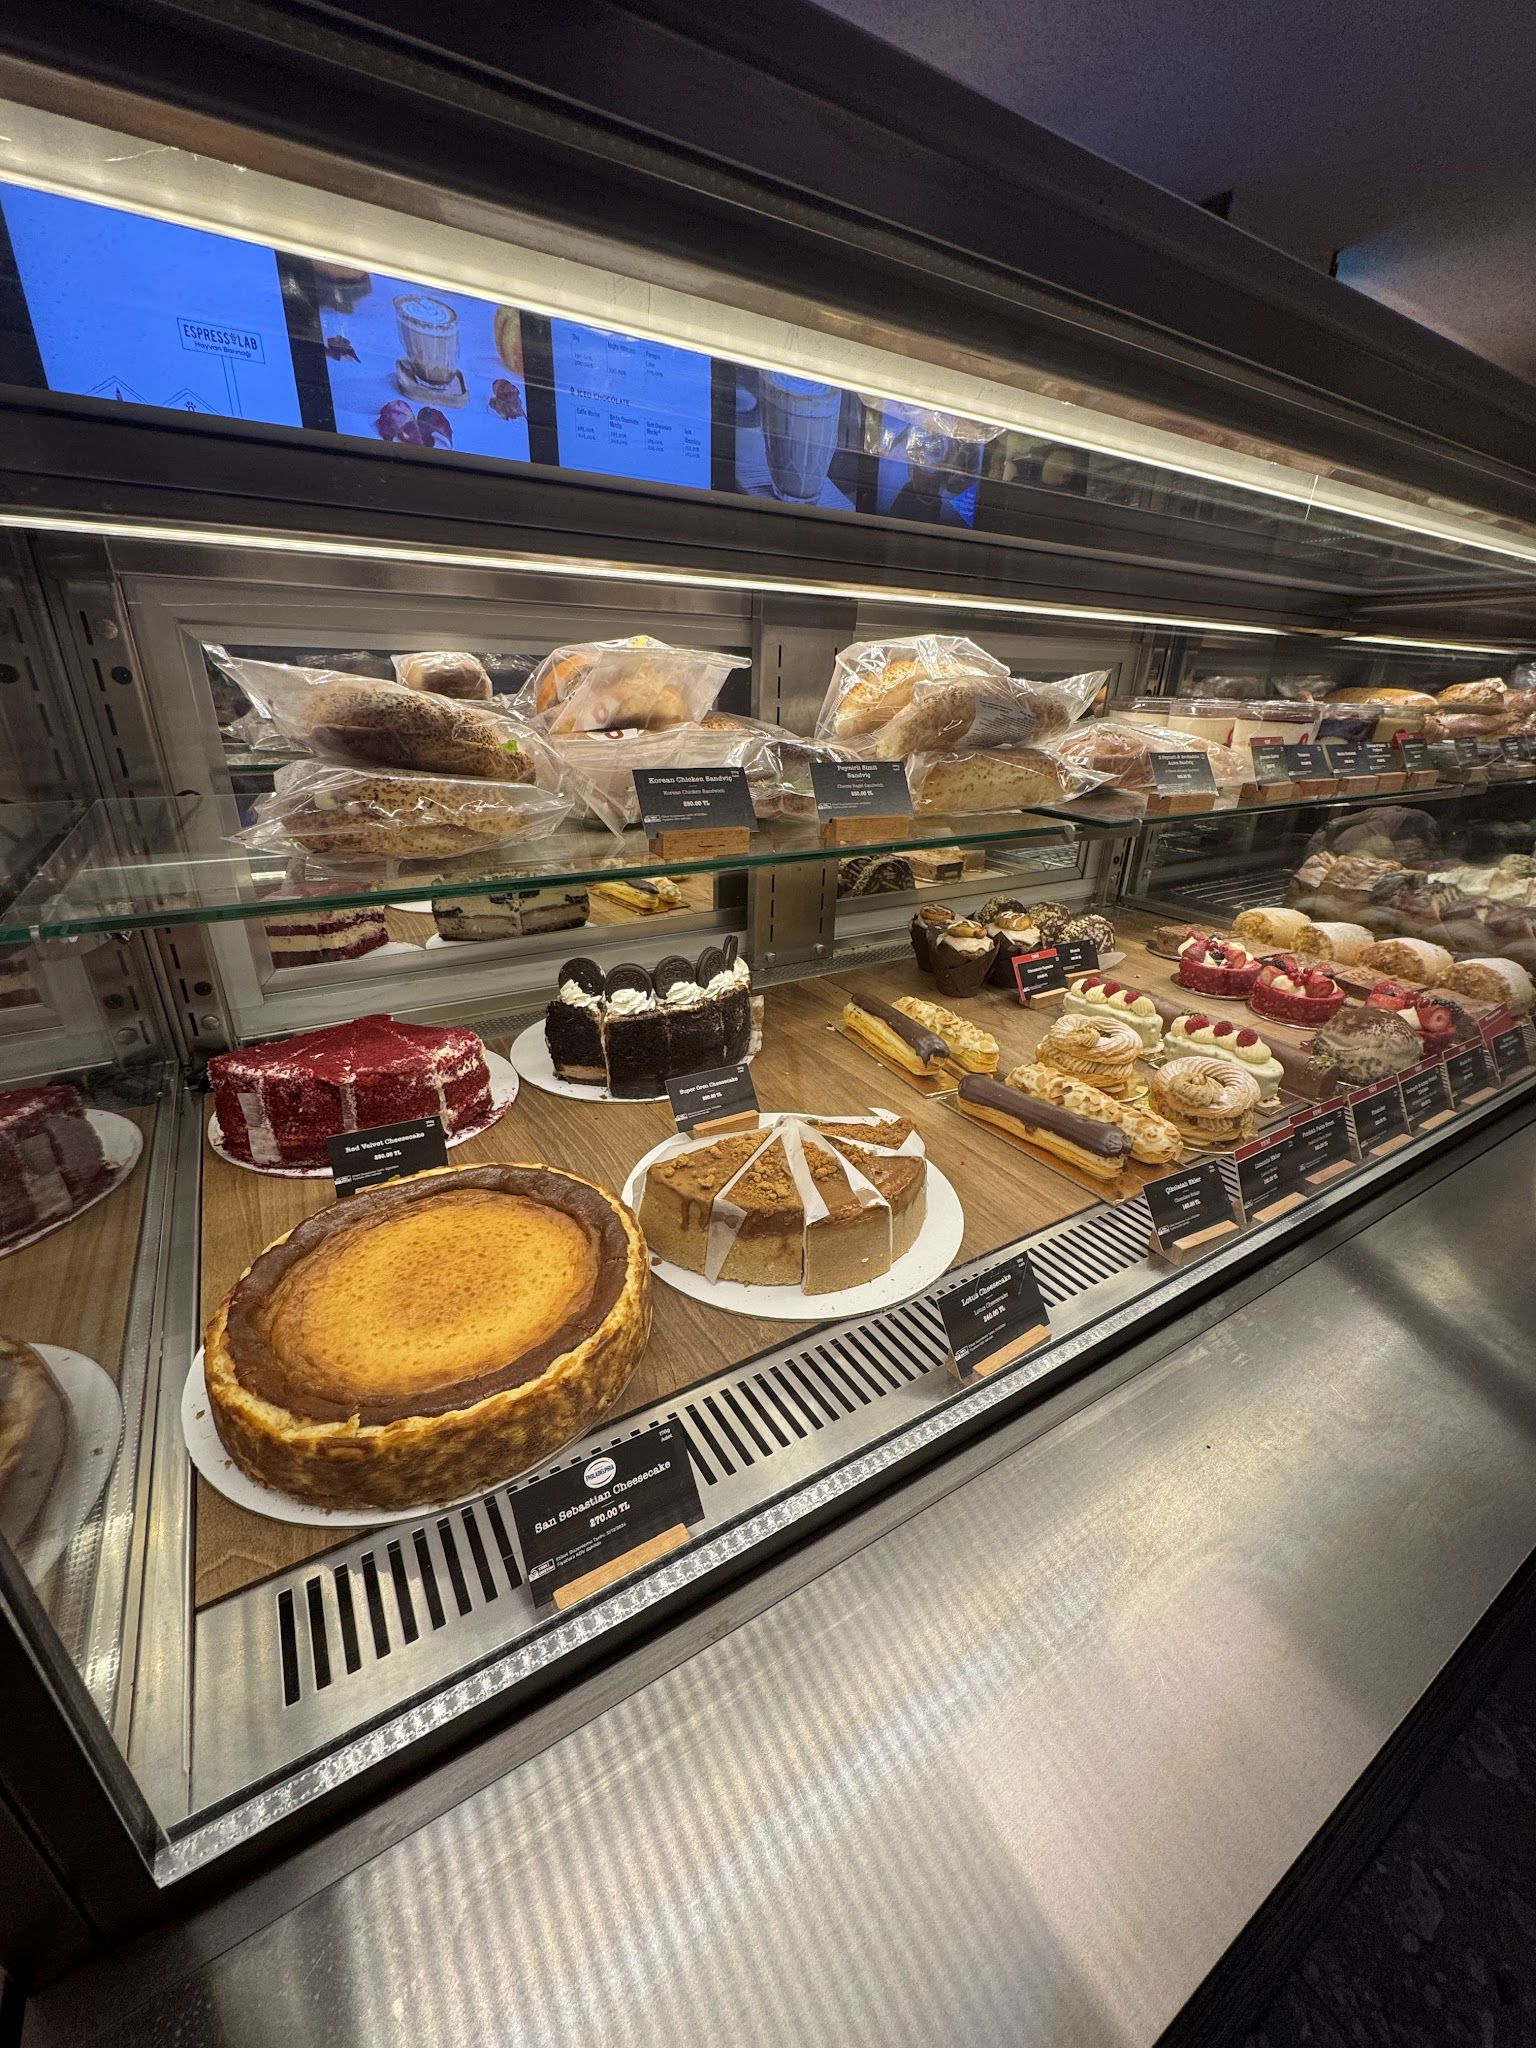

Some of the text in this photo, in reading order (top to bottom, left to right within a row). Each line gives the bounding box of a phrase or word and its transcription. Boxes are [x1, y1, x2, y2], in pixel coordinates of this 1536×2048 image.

[594, 392, 630, 407] CHOCOLATE
[648, 775, 732, 785] Korean Chicken Sandviç
[680, 1087, 696, 1095] Super
[709, 1077, 738, 1088] Cheesecake
[345, 1132, 425, 1153] Red Velvet Cheesecake
[961, 1274, 1012, 1307] Lotus Cheesecake
[986, 1292, 1009, 1308] Cheesecake
[998, 1305, 1006, 1313] TL
[660, 1433, 673, 1442] Adet
[585, 1464, 615, 1482] PHILADELPHIA
[534, 1460, 671, 1535] San Sebastian Cheesecake
[589, 1501, 631, 1528] 270.00 TL
